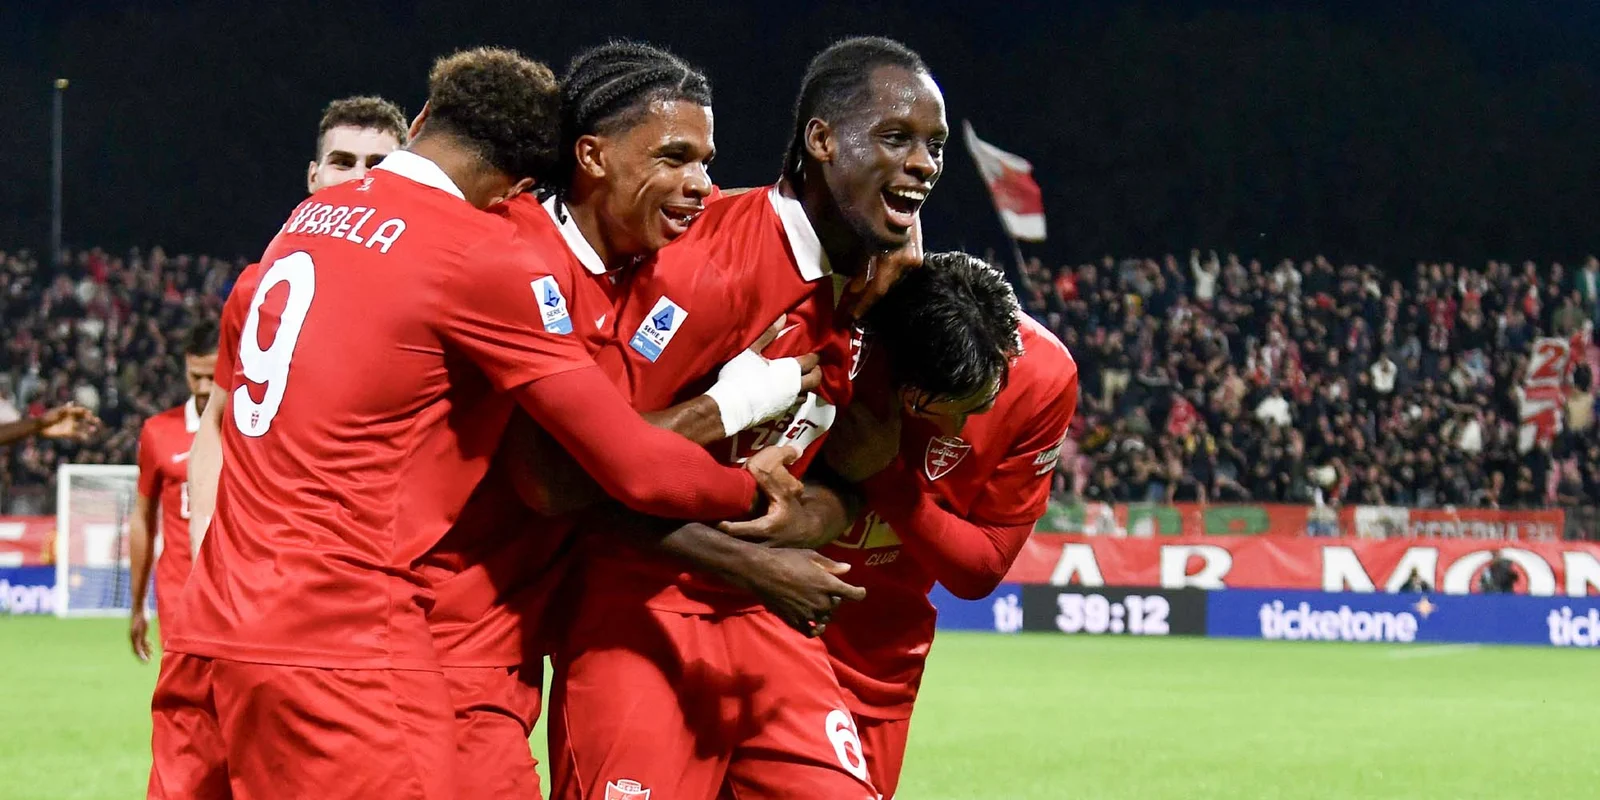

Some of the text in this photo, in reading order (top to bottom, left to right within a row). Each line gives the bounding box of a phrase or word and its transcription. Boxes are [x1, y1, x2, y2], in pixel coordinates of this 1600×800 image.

[286, 201, 407, 254] VARELA
[233, 251, 316, 437] 9
[644, 324, 660, 338] SERIE
[864, 549, 900, 567] CLUB
[1055, 593, 1170, 635] 39:12
[1259, 600, 1419, 642] ticketone
[825, 709, 868, 781] 6
